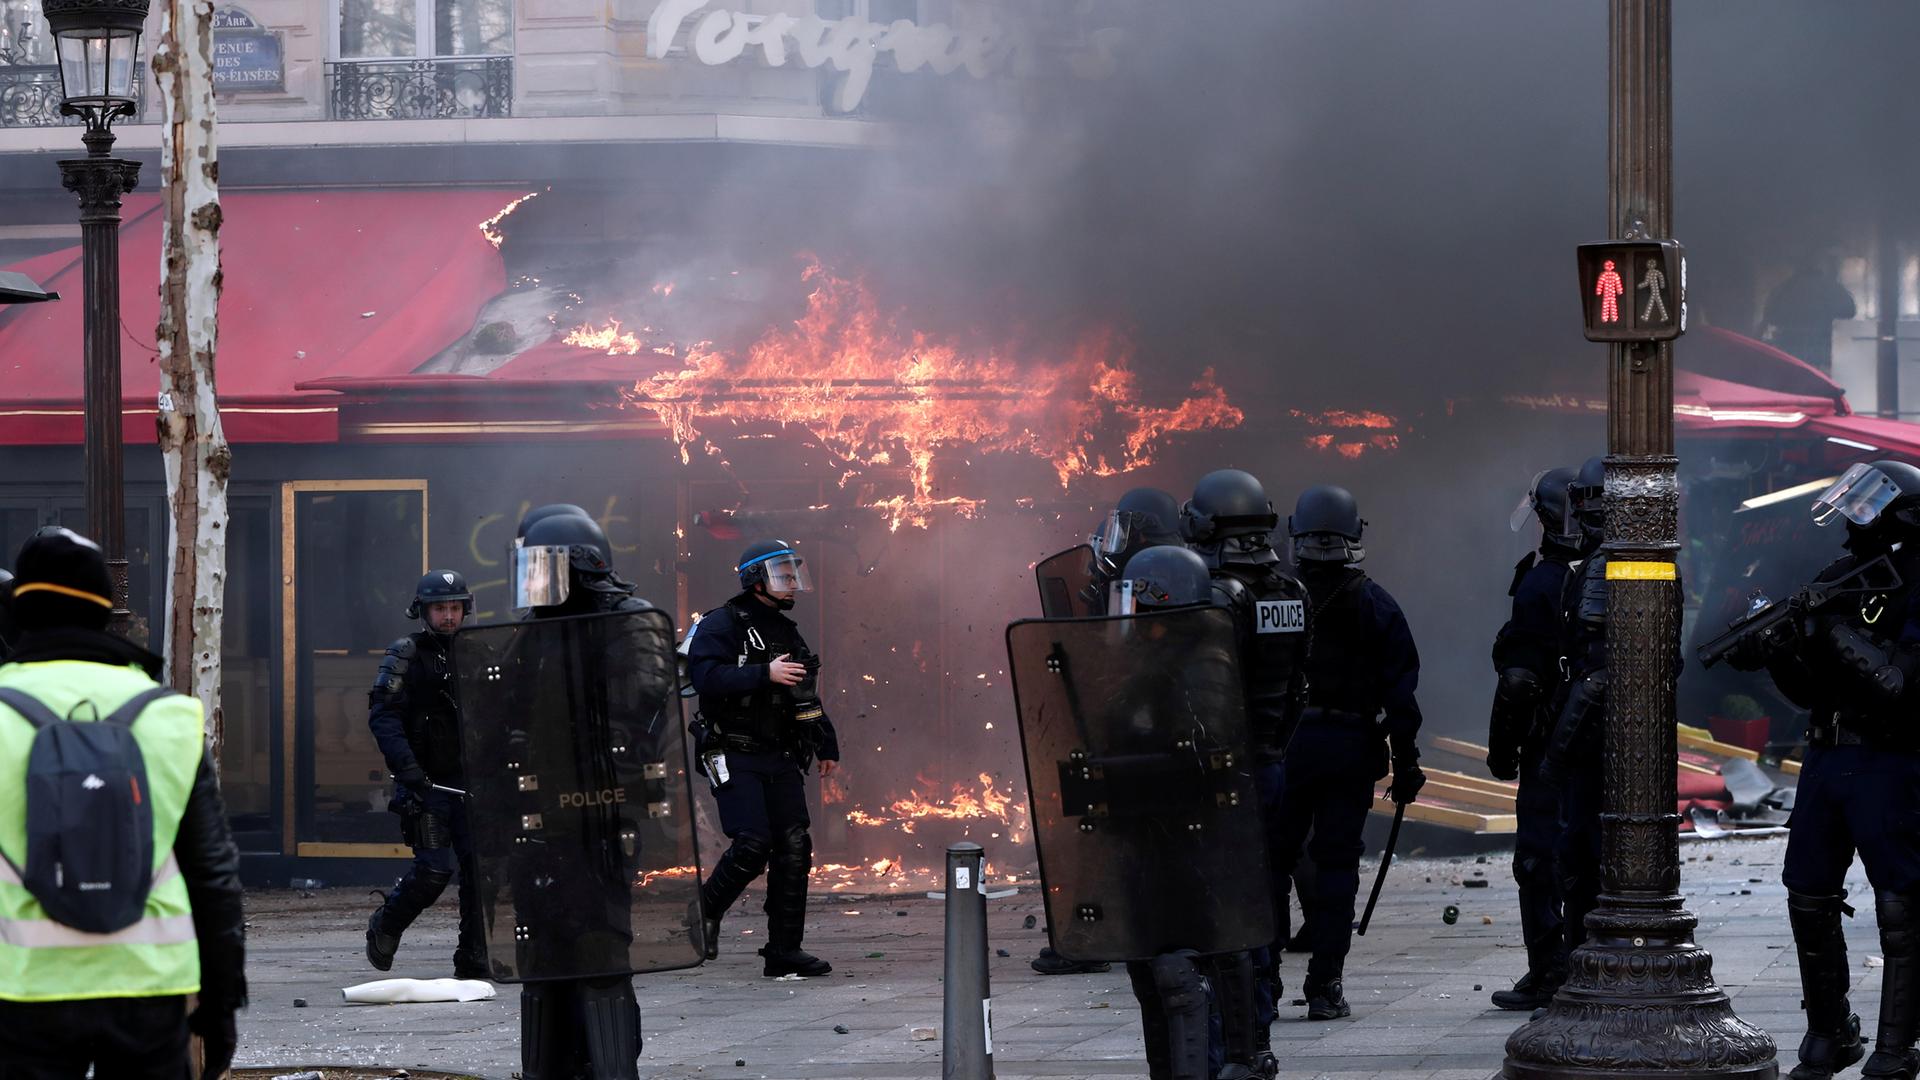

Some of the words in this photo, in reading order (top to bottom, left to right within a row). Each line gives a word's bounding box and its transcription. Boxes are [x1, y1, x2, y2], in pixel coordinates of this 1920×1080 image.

[217, 57, 240, 67] DES
[1260, 604, 1303, 629] POLICE
[560, 788, 626, 808] POLICE
